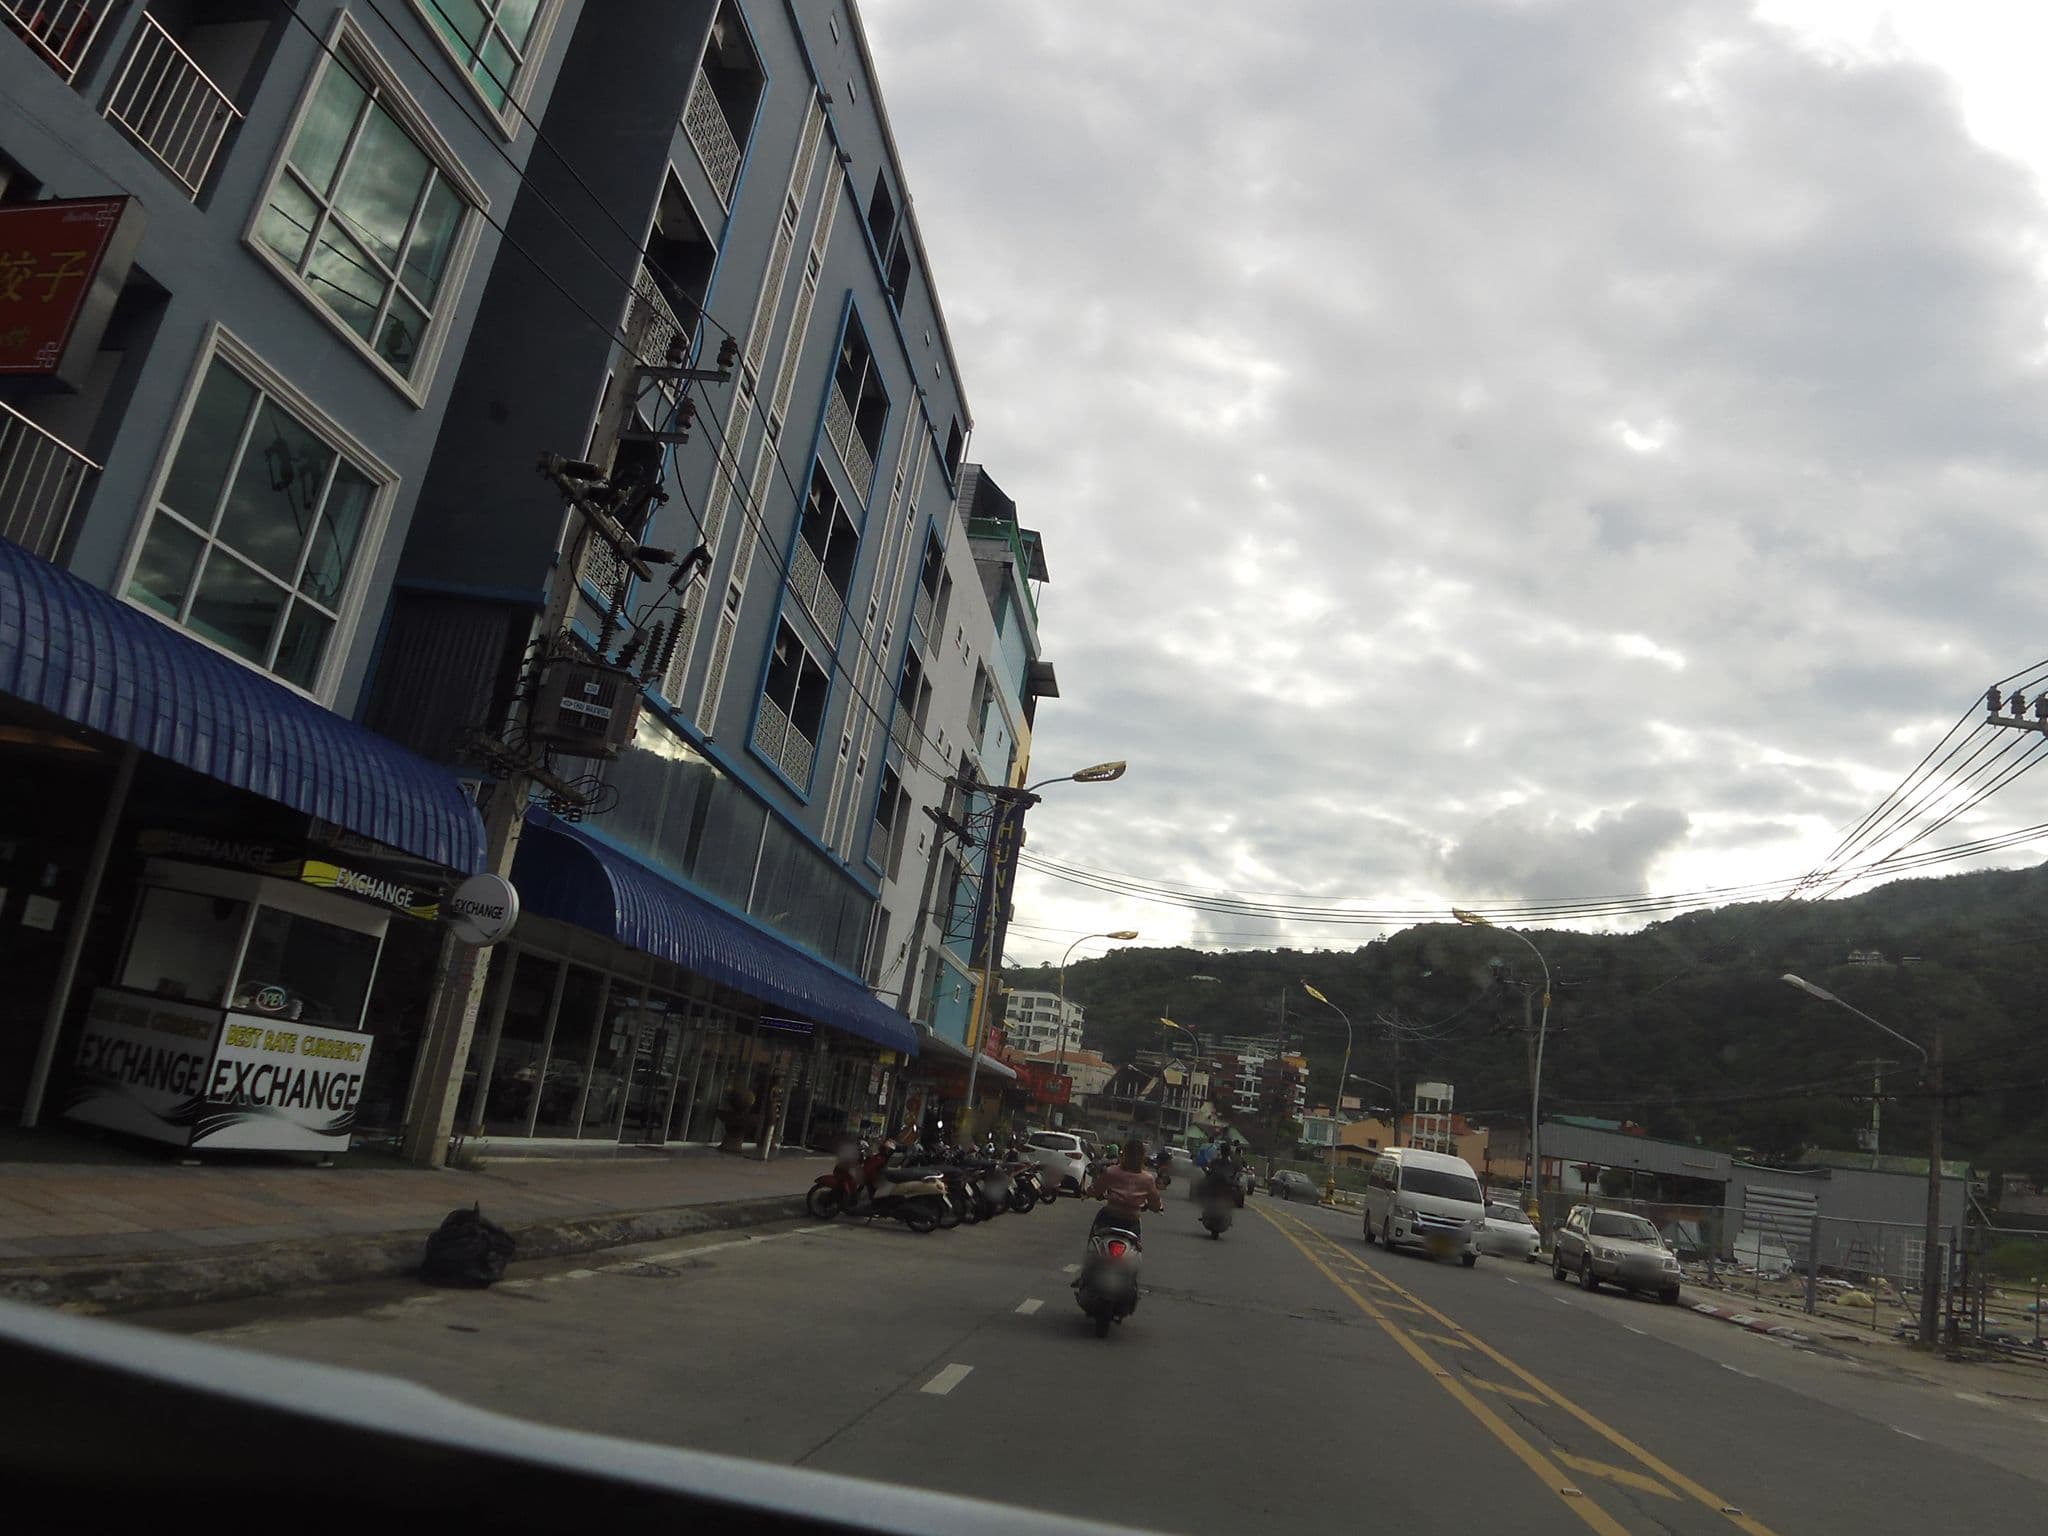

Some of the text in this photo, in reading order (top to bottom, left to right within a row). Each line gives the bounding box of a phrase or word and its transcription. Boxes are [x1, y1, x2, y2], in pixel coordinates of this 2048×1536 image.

[335, 867, 416, 908] EXCHANGE
[453, 898, 505, 920] EXCHANGE
[226, 1024, 367, 1062] BEST RATE CURRENCY
[79, 1032, 205, 1097] EXCHANGE
[209, 1058, 362, 1112] EXCHANGE
